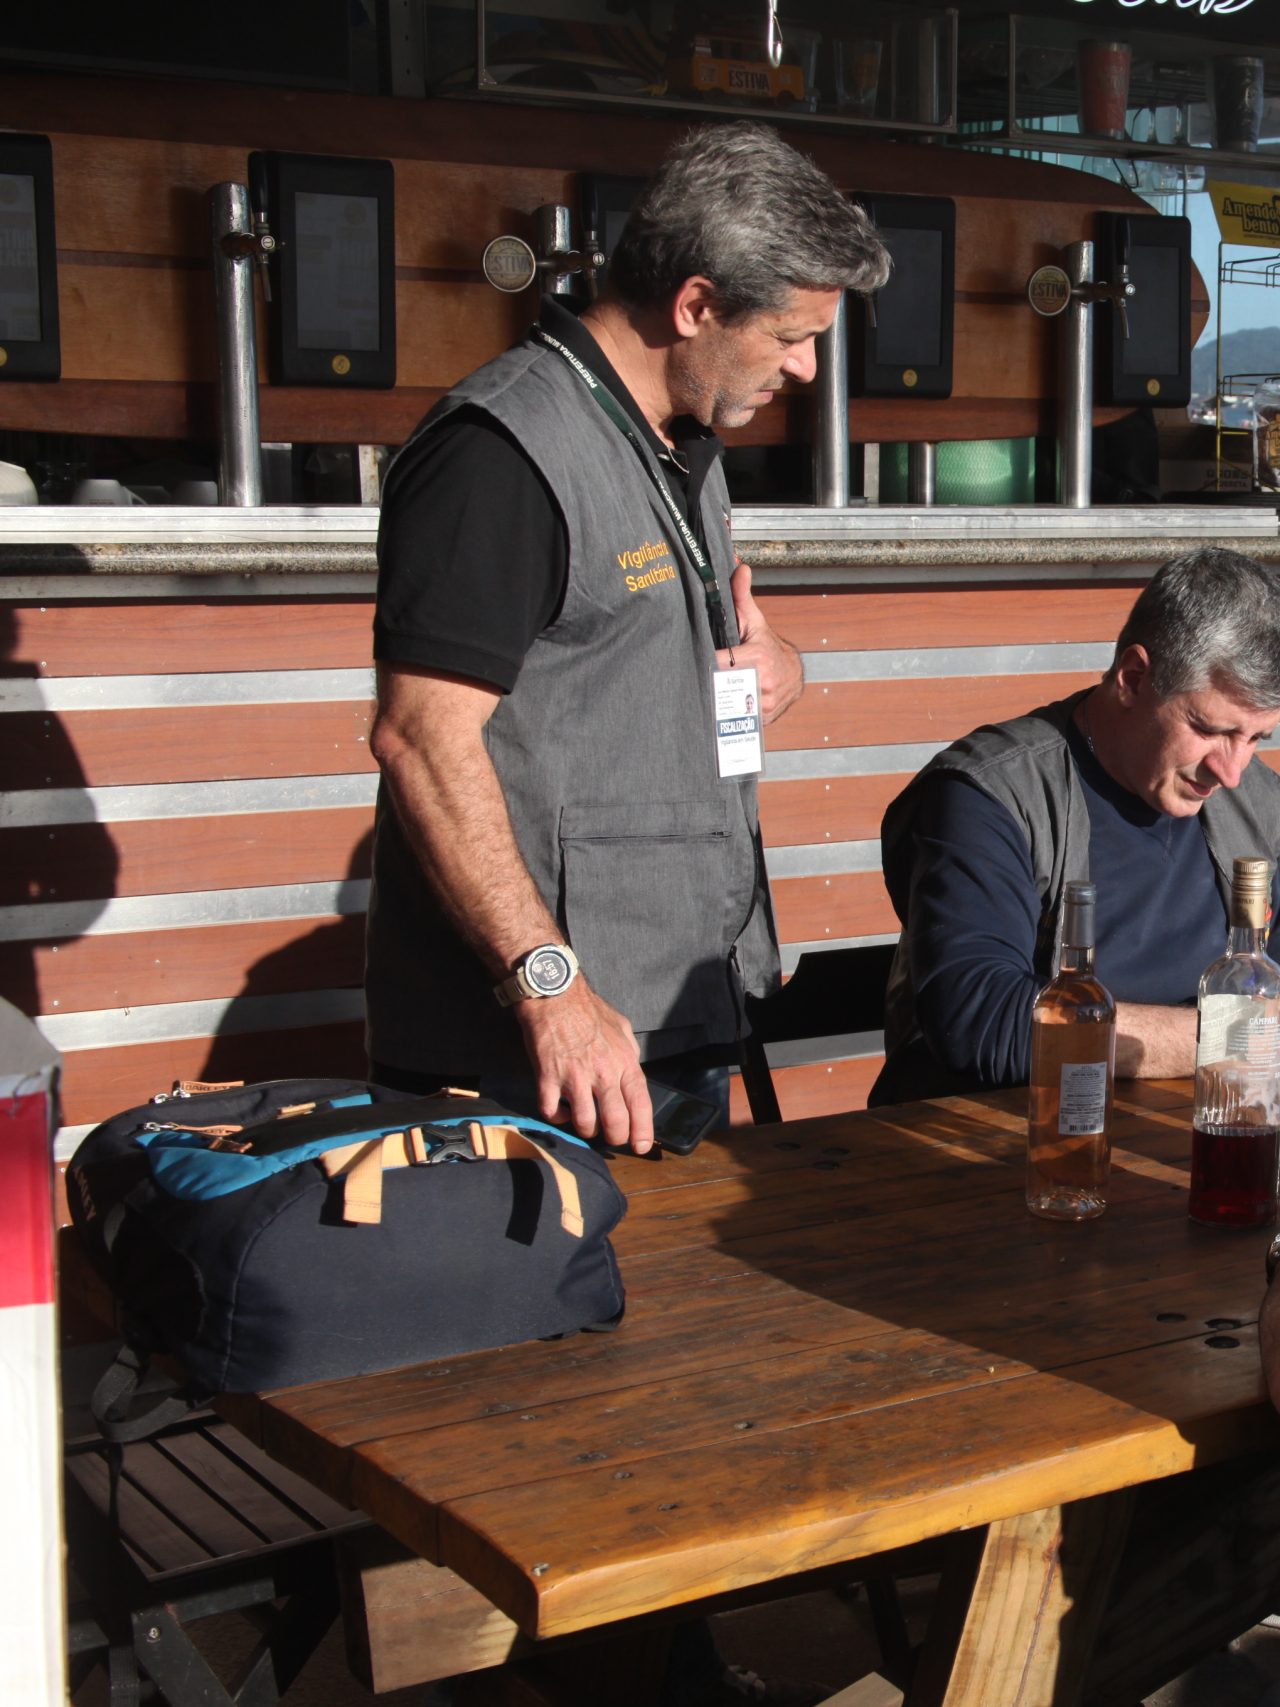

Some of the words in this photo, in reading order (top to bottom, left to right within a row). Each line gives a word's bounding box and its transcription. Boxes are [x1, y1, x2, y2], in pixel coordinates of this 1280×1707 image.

[728, 69, 770, 91] ESTIVA
[1222, 196, 1277, 219] Amendo
[1242, 217, 1280, 234] bento
[560, 345, 598, 389] PREFEITURA
[617, 539, 670, 570] Vigilância
[678, 520, 707, 568] PREFEITURA
[625, 563, 676, 592] Sanitária
[1248, 1016, 1278, 1026] CAMPARI
